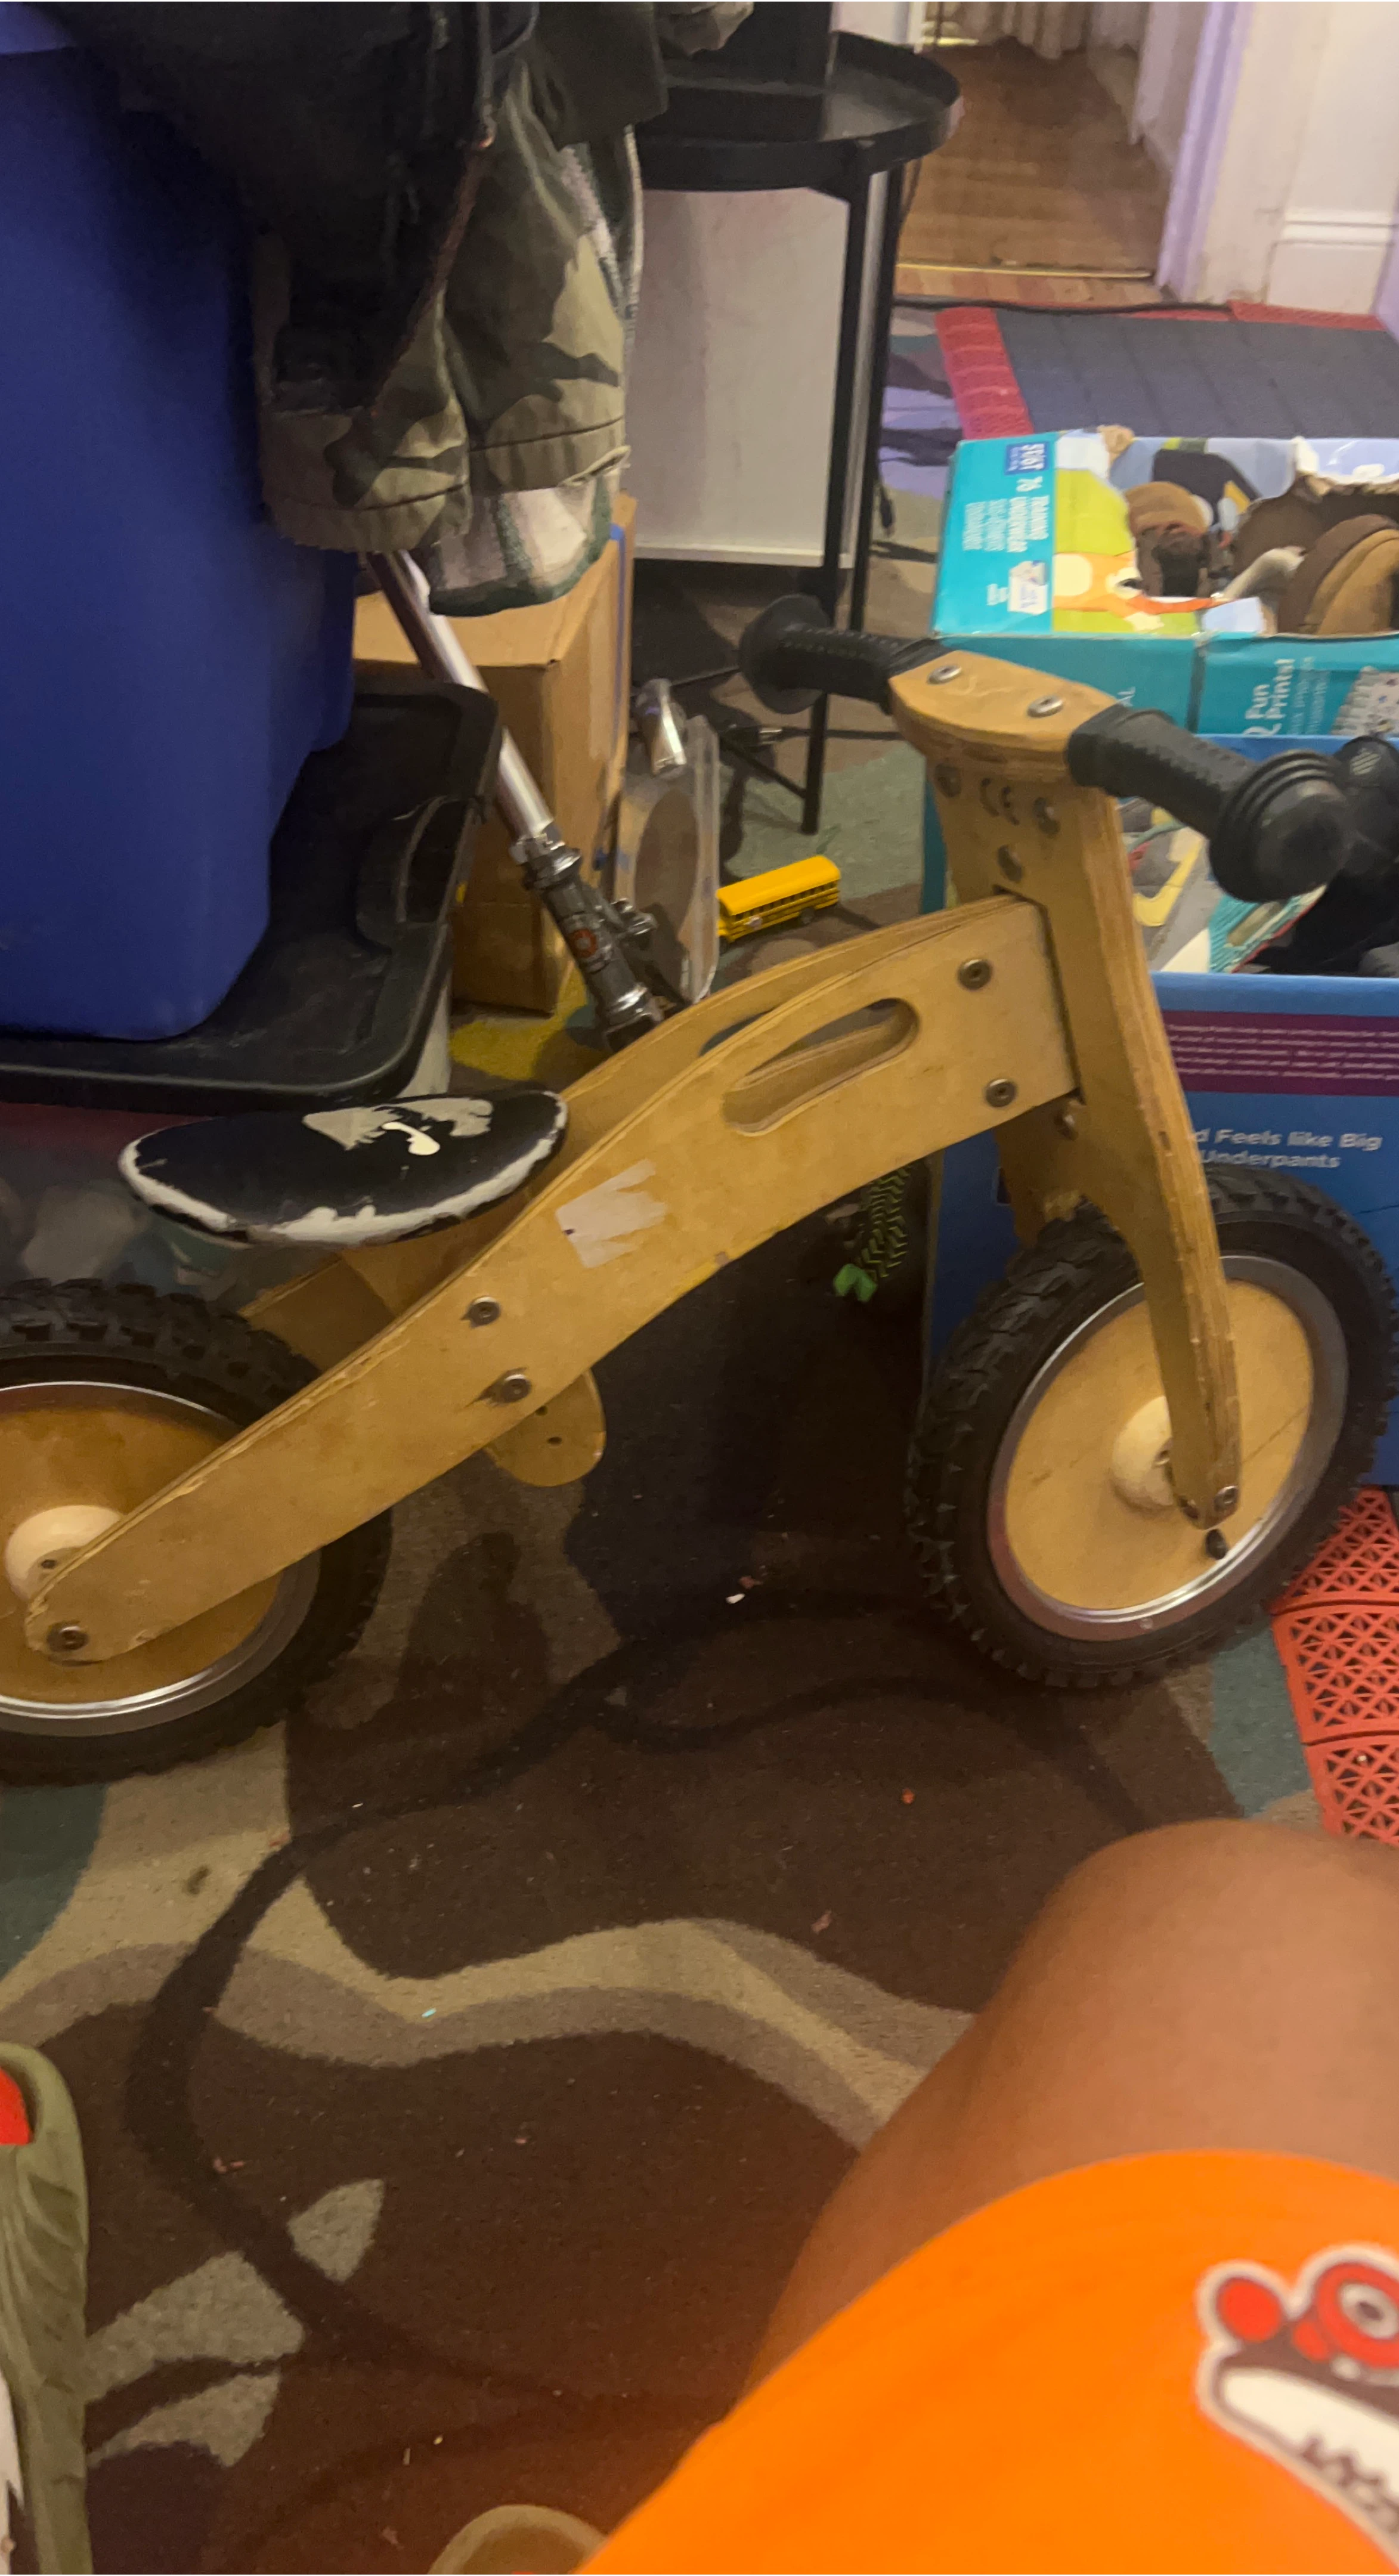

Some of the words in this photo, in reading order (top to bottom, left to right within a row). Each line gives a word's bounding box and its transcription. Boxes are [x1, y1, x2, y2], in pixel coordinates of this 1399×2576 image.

[1245, 684, 1271, 720] Fun
[1214, 1129, 1282, 1145] Feels
[1287, 1131, 1334, 1147] like
[1339, 1133, 1383, 1151] Big
